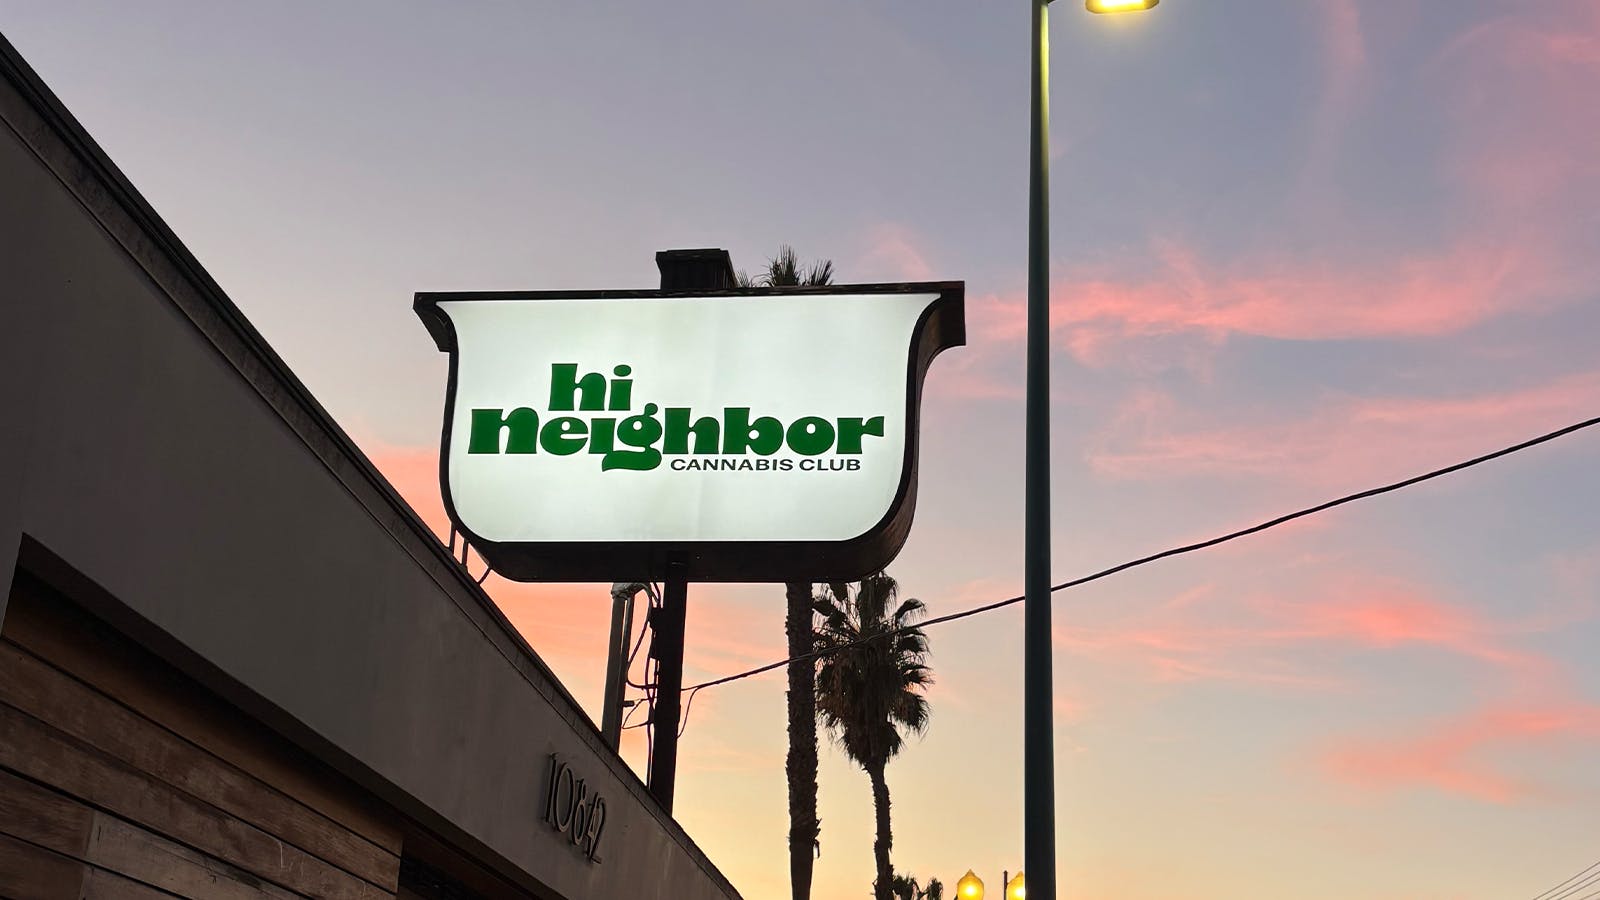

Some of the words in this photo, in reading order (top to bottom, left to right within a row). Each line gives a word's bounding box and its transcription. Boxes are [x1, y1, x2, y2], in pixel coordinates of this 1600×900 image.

[548, 363, 633, 412] hi
[467, 402, 885, 472] neighbor
[670, 458, 794, 471] CANNABIS
[799, 459, 861, 472] CLUB
[543, 752, 606, 864] 10842
